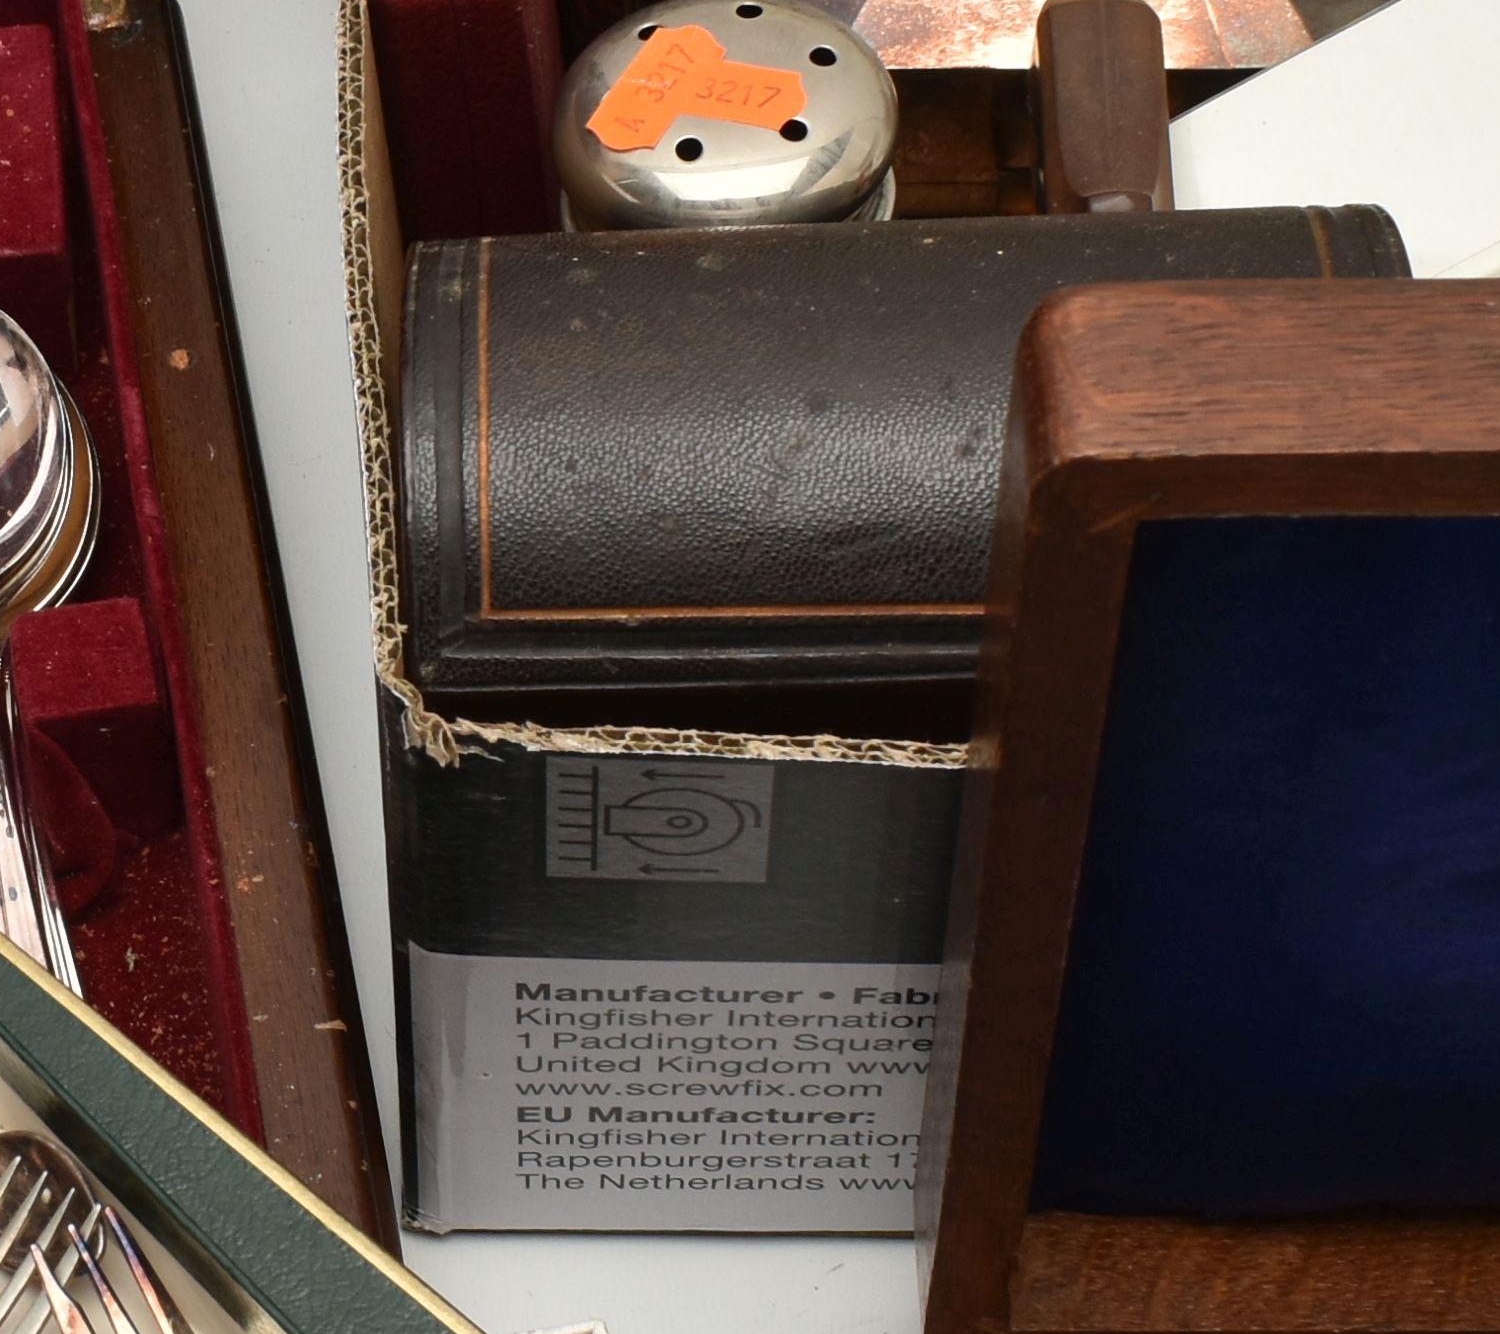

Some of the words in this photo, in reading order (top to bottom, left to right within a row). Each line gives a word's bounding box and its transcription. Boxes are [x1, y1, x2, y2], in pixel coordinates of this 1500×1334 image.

[696, 75, 782, 109] 3217
[515, 982, 804, 1003] Manufacturer
[853, 987, 939, 1005] Fab
[516, 1007, 714, 1031] Kingfisher
[727, 1010, 936, 1029] Internation
[516, 1032, 531, 1050] 1
[553, 1032, 777, 1054] Paddington
[793, 1033, 934, 1055] Square
[516, 1055, 641, 1073] United
[657, 1056, 831, 1078] Kingdom
[515, 1079, 883, 1096] www.screwfix.com
[516, 1106, 572, 1123] EU
[588, 1106, 876, 1124] Manufacturer:
[517, 1128, 706, 1150] Kingfisher
[720, 1129, 920, 1147] Internation
[518, 1151, 871, 1172] Rapenburgerstraat
[516, 1173, 585, 1190] The
[600, 1173, 825, 1190] Netherlands
